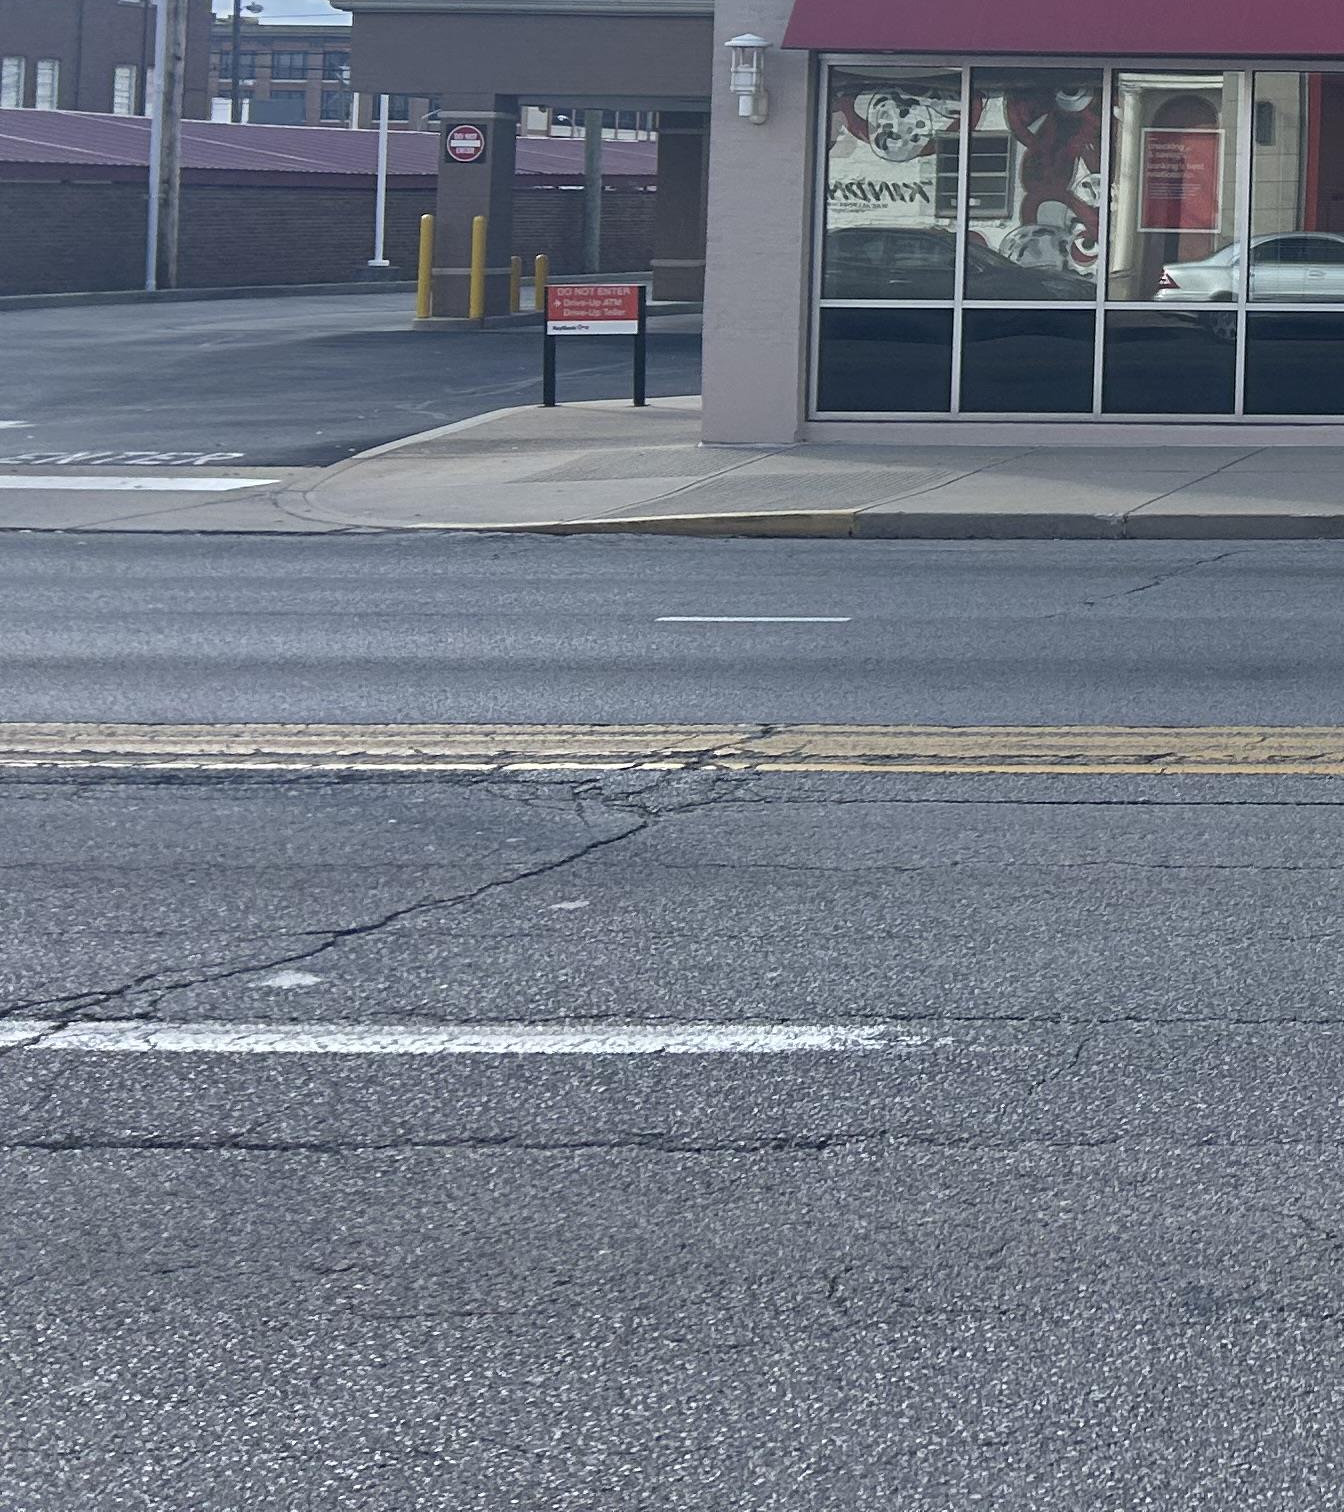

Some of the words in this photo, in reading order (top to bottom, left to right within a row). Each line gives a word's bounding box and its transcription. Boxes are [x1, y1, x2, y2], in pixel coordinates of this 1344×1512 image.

[557, 287, 573, 296] DO
[574, 287, 595, 296] NOT
[597, 287, 631, 296] ENTER
